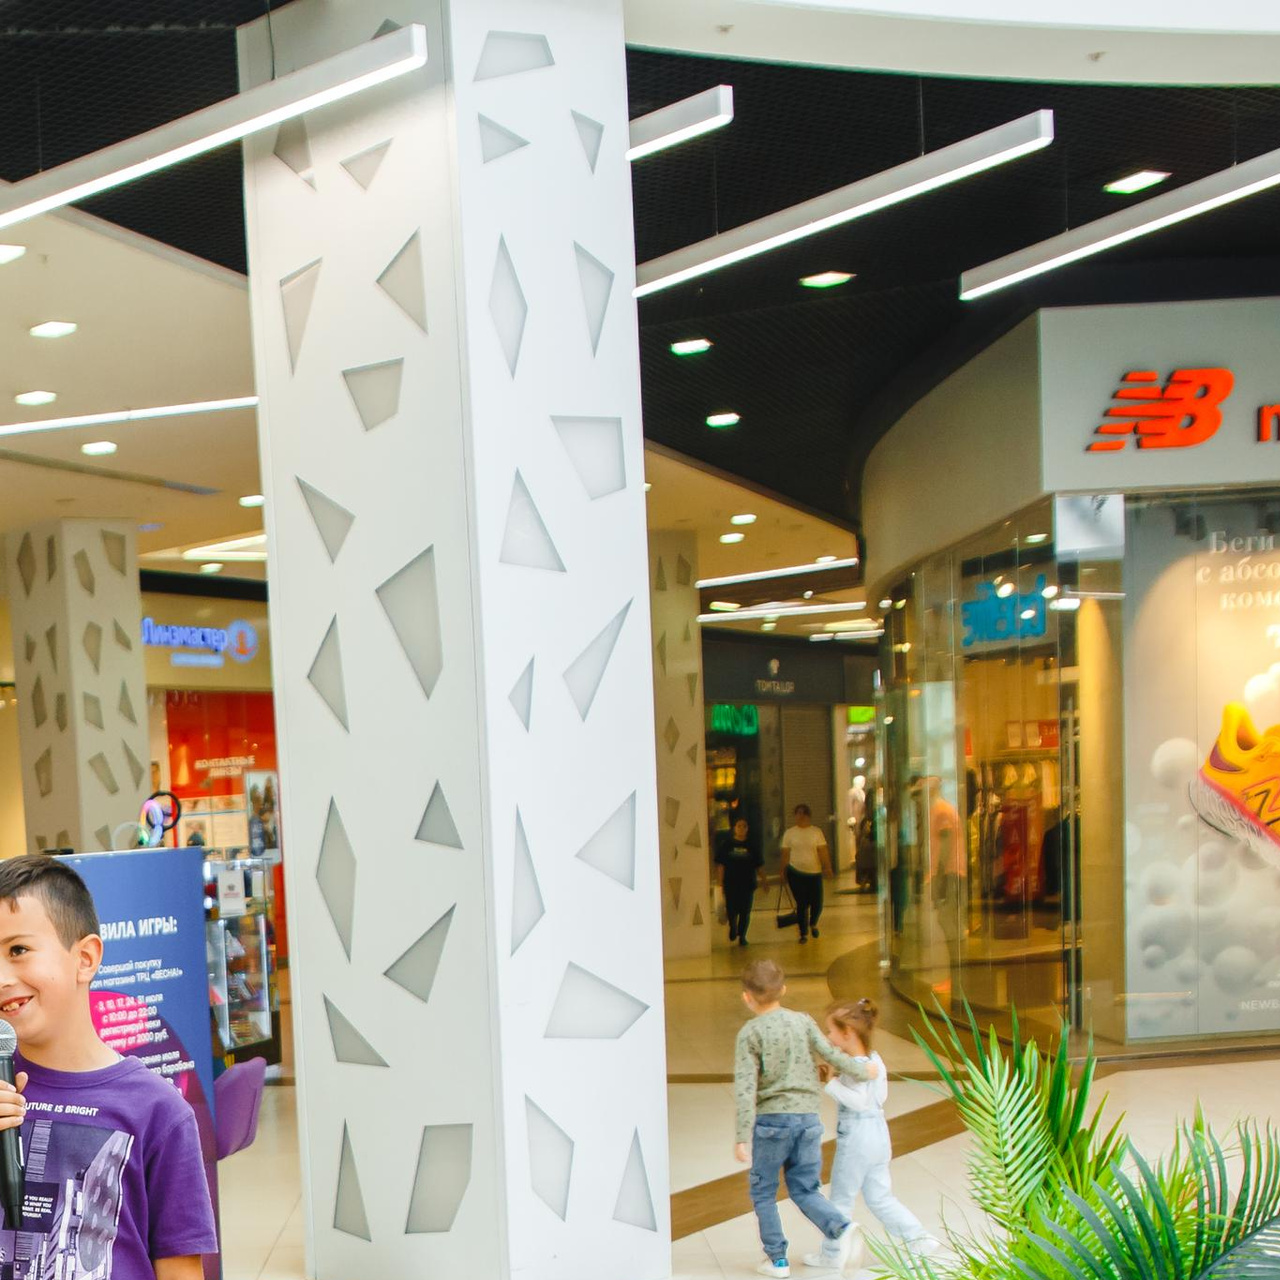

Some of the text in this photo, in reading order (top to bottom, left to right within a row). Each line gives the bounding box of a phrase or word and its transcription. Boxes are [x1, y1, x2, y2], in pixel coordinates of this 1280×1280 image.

[138, 915, 178, 936] ИГРЫ:
[21, 1102, 99, 1117] UTURE IS BRIGHT
